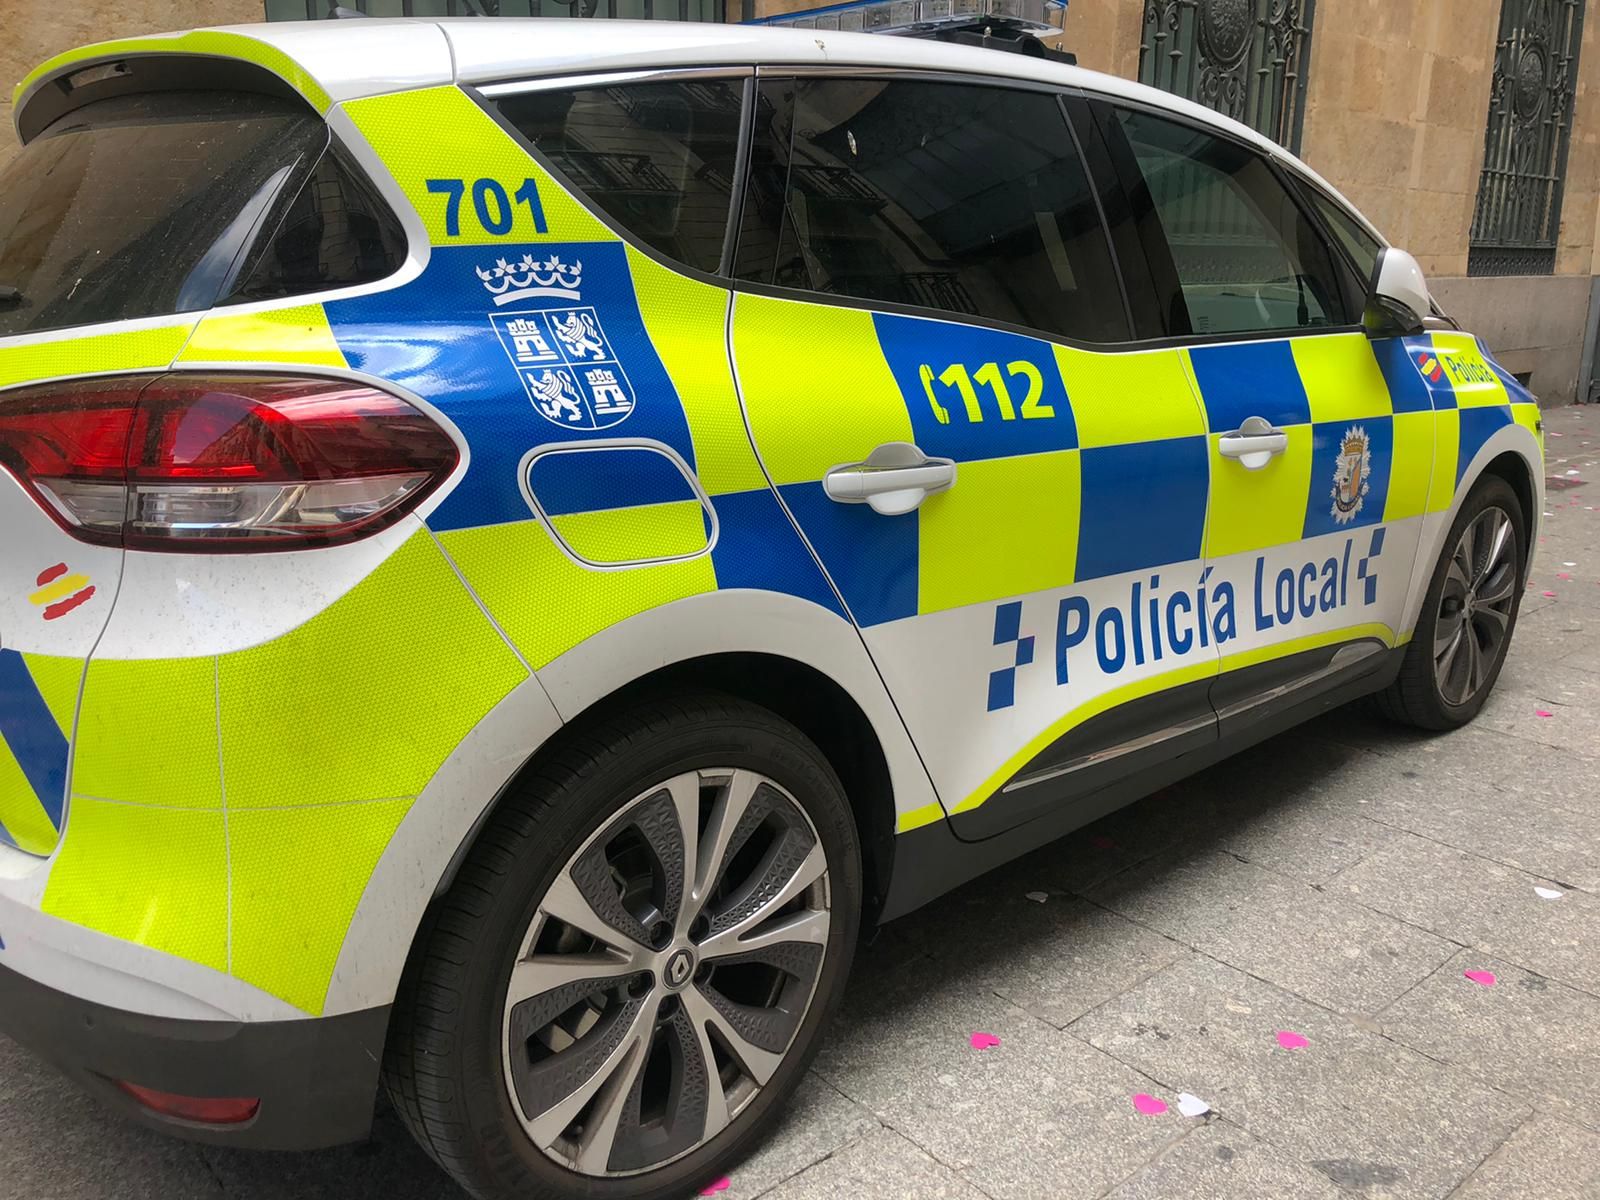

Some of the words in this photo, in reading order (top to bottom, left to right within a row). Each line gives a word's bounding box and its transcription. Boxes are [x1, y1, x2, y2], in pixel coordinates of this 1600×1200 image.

[426, 179, 548, 236] 701
[938, 361, 1055, 423] 112
[1055, 567, 1237, 686] Policía
[1254, 539, 1353, 632] Local
